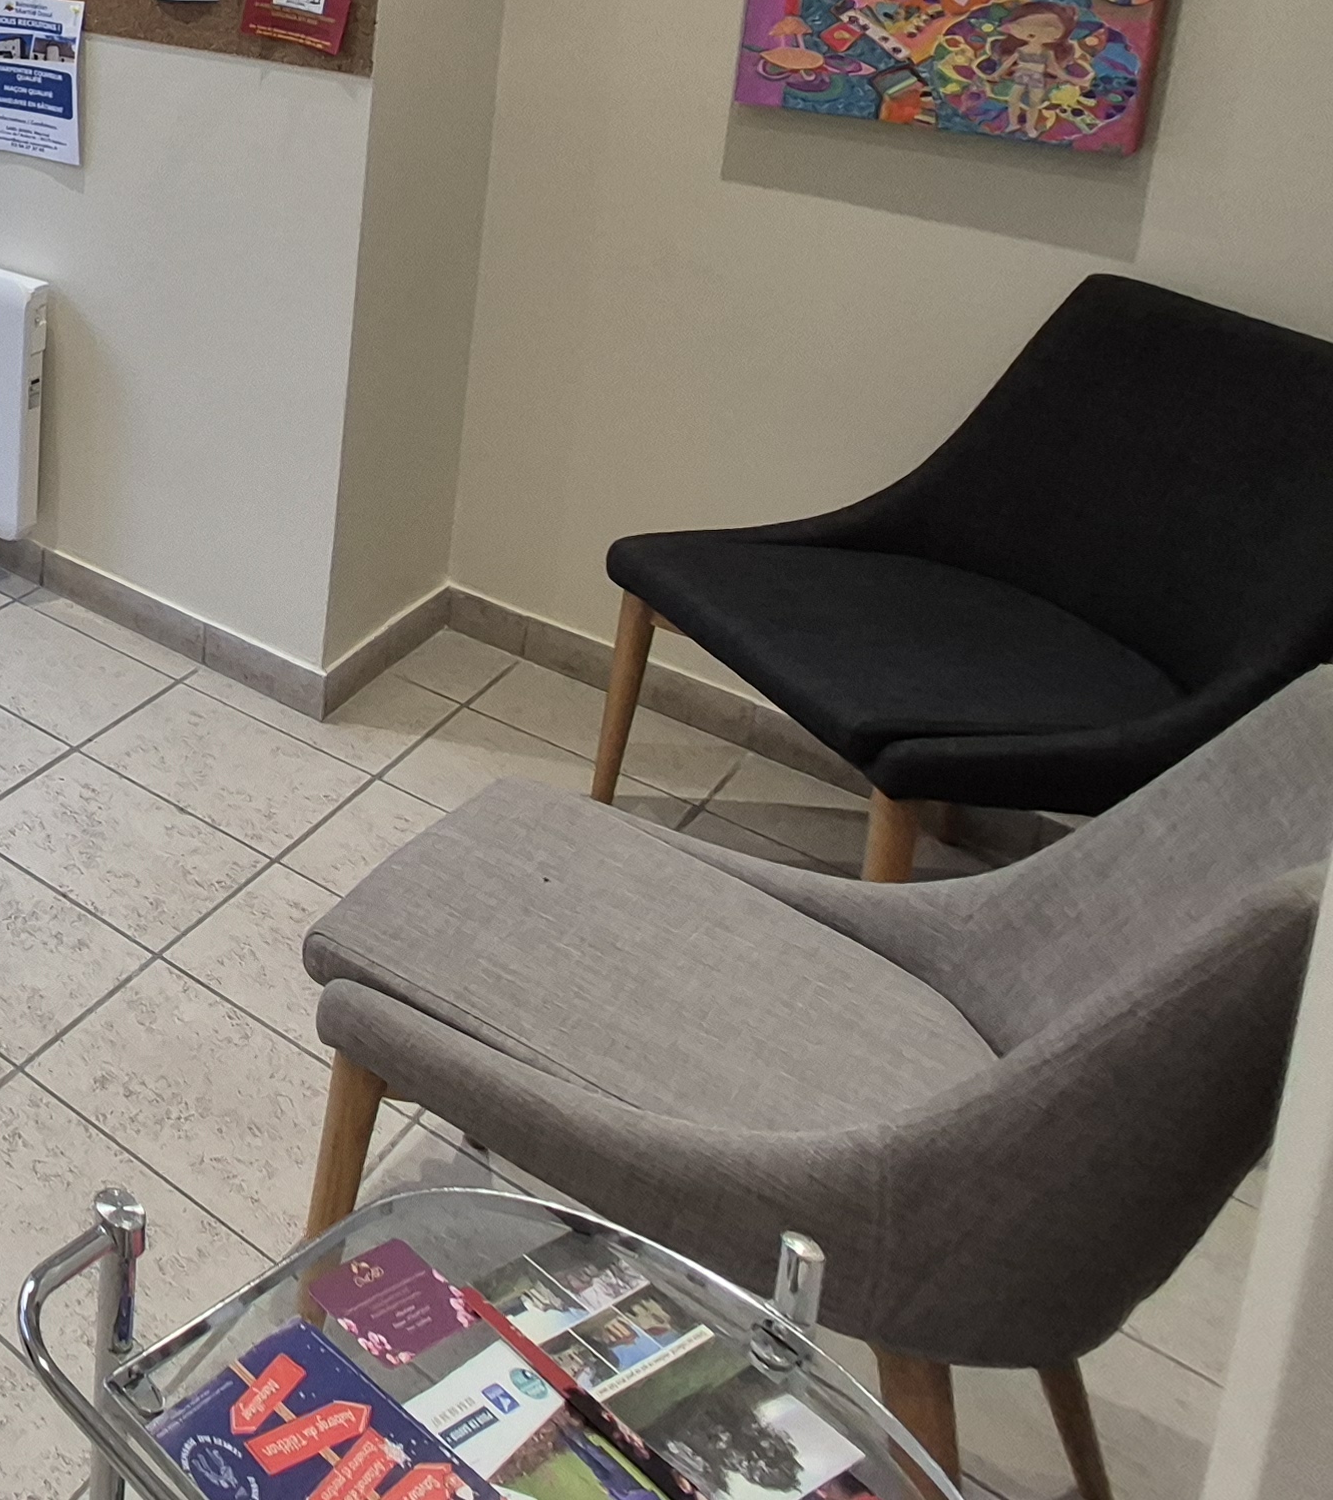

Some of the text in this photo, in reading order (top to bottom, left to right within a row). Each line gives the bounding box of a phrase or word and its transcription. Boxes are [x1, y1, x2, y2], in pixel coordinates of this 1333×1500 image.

[17, 19, 57, 32] RECRUTONS
[3, 84, 28, 94] MAÇON
[467, 1418, 479, 1430] EN
[476, 1409, 494, 1425] POUR
[260, 1409, 356, 1458] Auberge du Téléthon
[449, 1423, 473, 1442] SAVOIR
